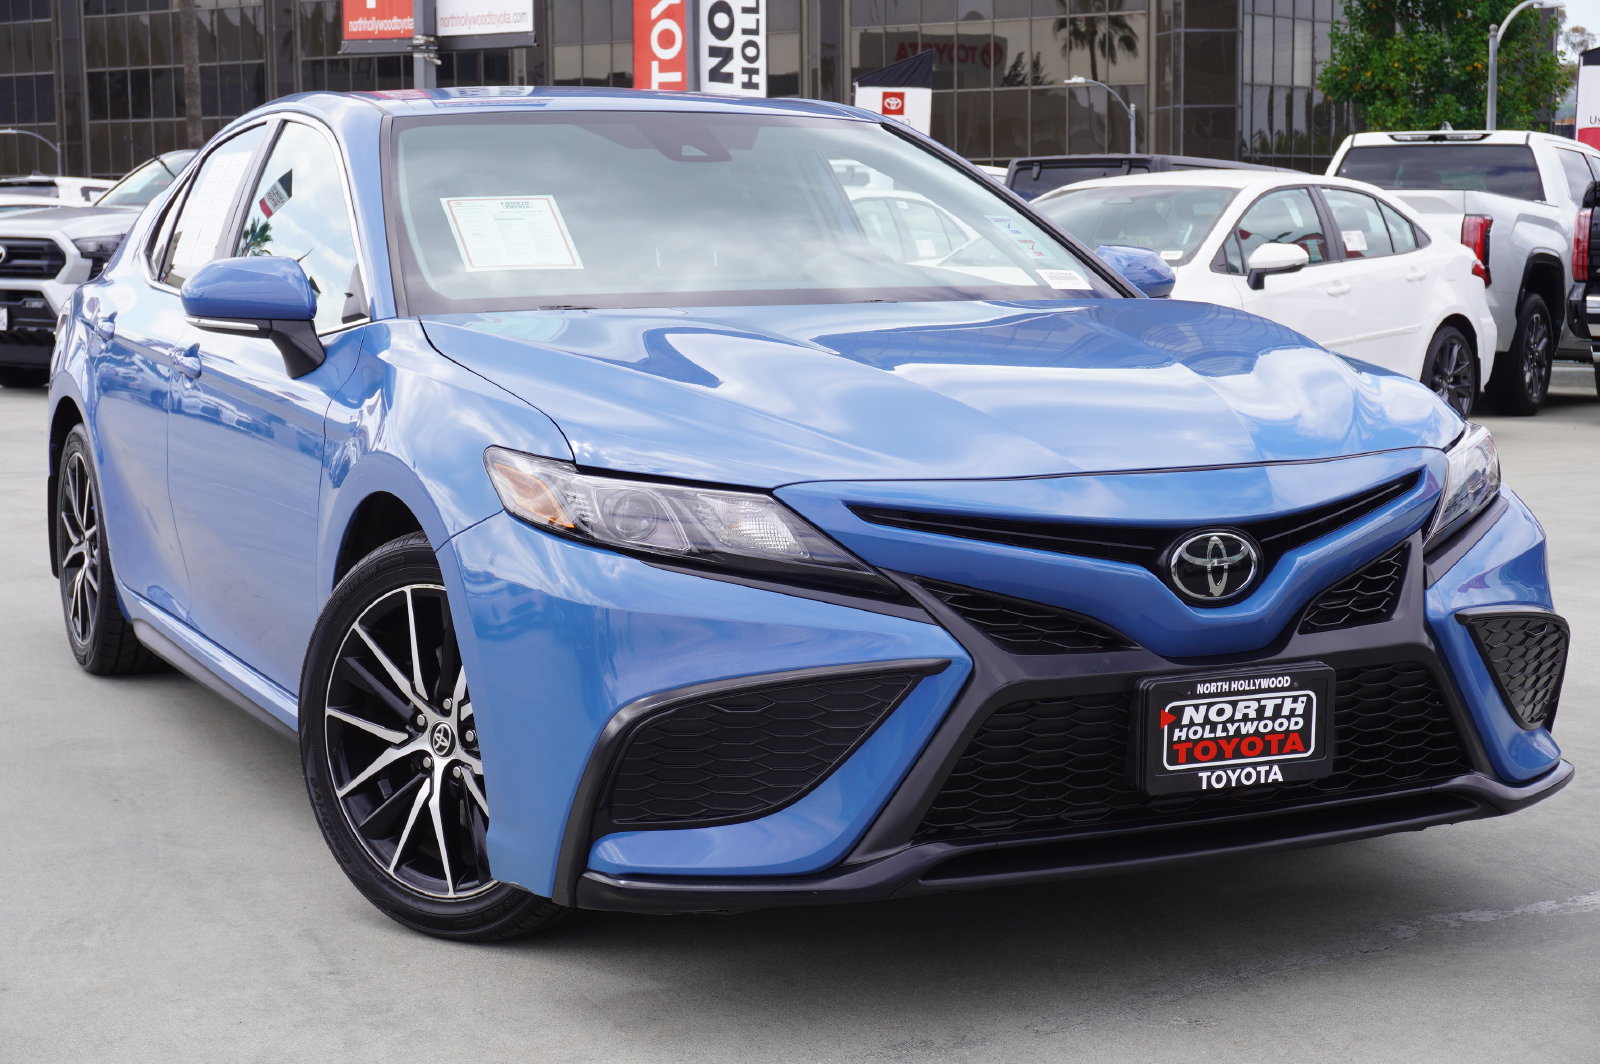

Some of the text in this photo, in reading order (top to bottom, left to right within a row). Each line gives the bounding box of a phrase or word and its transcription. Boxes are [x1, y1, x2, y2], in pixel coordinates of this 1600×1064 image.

[1196, 676, 1291, 695] NORTH HOLLYWOOD
[1181, 696, 1308, 725] NORTH
[1172, 717, 1304, 742] HOLLYWOOD
[1172, 732, 1306, 764] TOYOTA
[1198, 764, 1284, 790] TOYOTA
